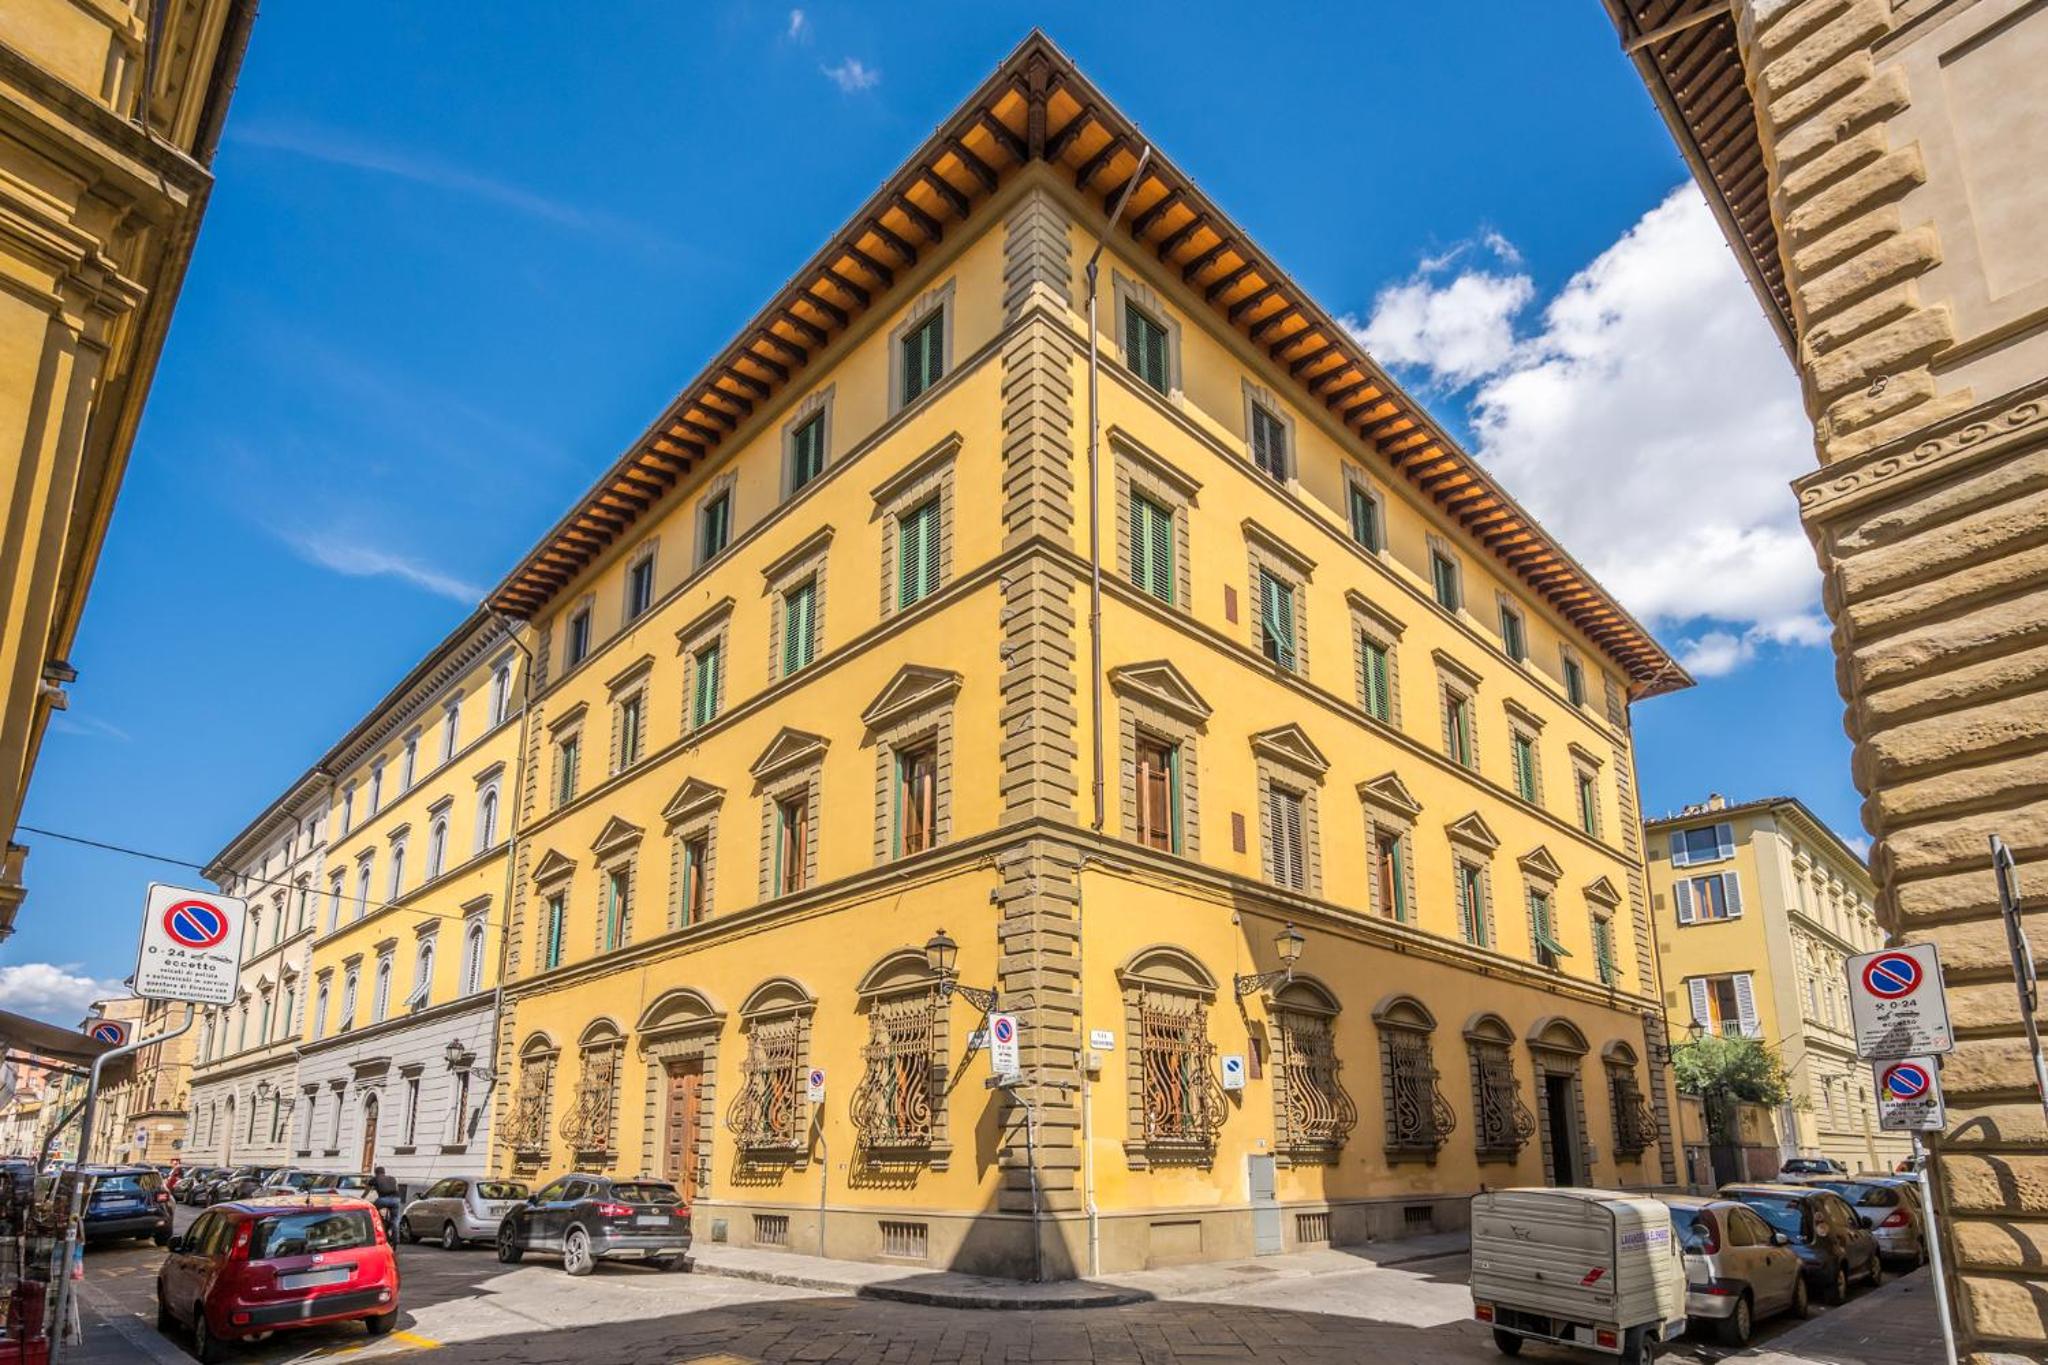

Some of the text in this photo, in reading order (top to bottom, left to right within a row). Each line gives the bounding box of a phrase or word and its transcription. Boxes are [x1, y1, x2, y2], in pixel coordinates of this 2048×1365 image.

[148, 946, 157, 954] 0
[167, 948, 185, 957] 24
[164, 959, 216, 971] eccetto
[1882, 1019, 1917, 1028] eccetto
